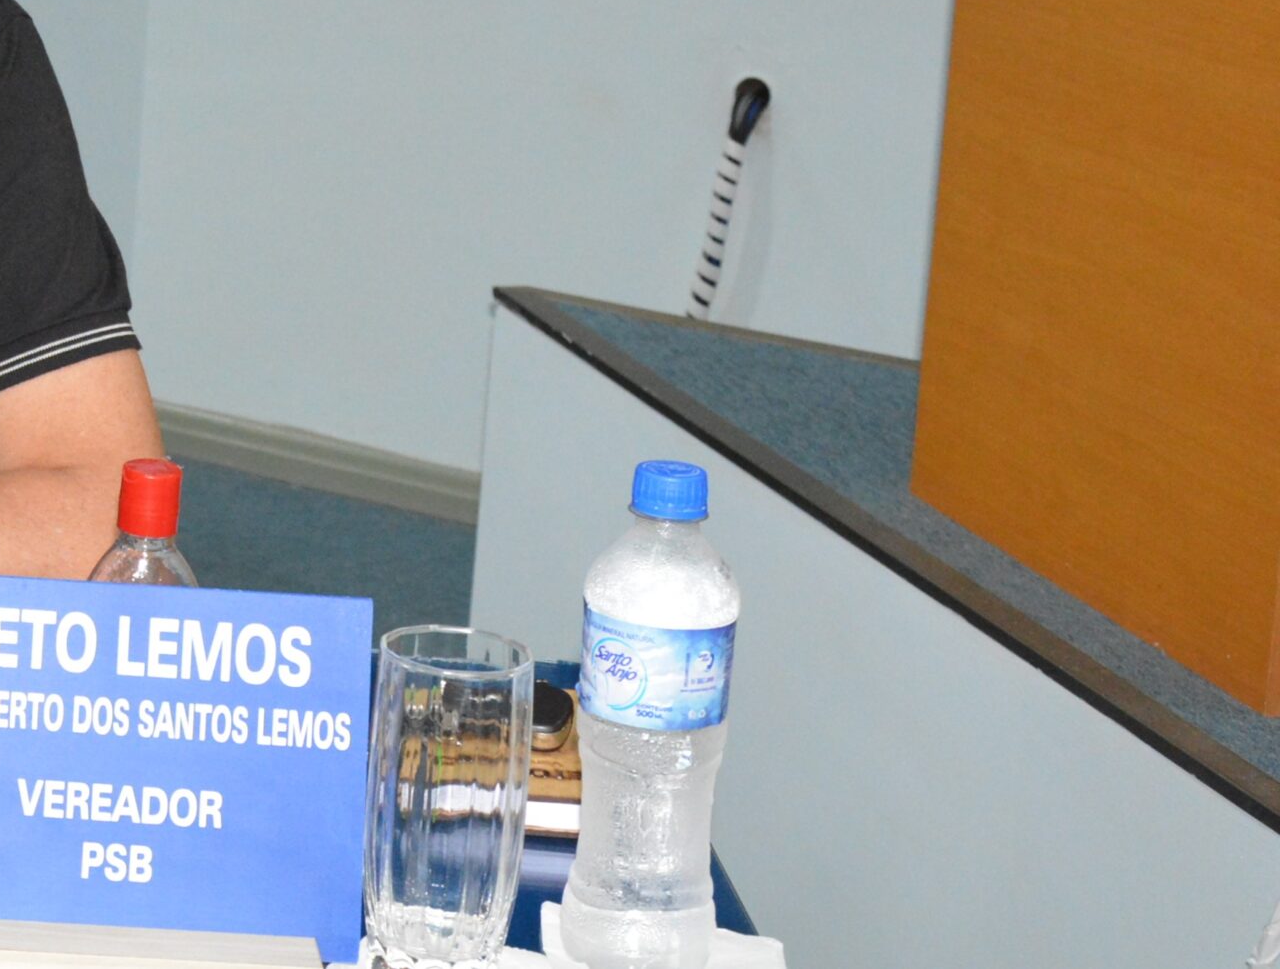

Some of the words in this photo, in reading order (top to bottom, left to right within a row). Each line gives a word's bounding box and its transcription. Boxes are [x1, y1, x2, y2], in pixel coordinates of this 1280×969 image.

[116, 615, 312, 688] LEMOS
[595, 645, 632, 666] Santo
[605, 664, 637, 682] Anjo
[71, 695, 131, 736] DOS
[137, 699, 249, 744] SANTOS
[256, 707, 352, 751] LEMOS
[17, 777, 224, 829] VEREADOR
[80, 841, 154, 884] PSB
